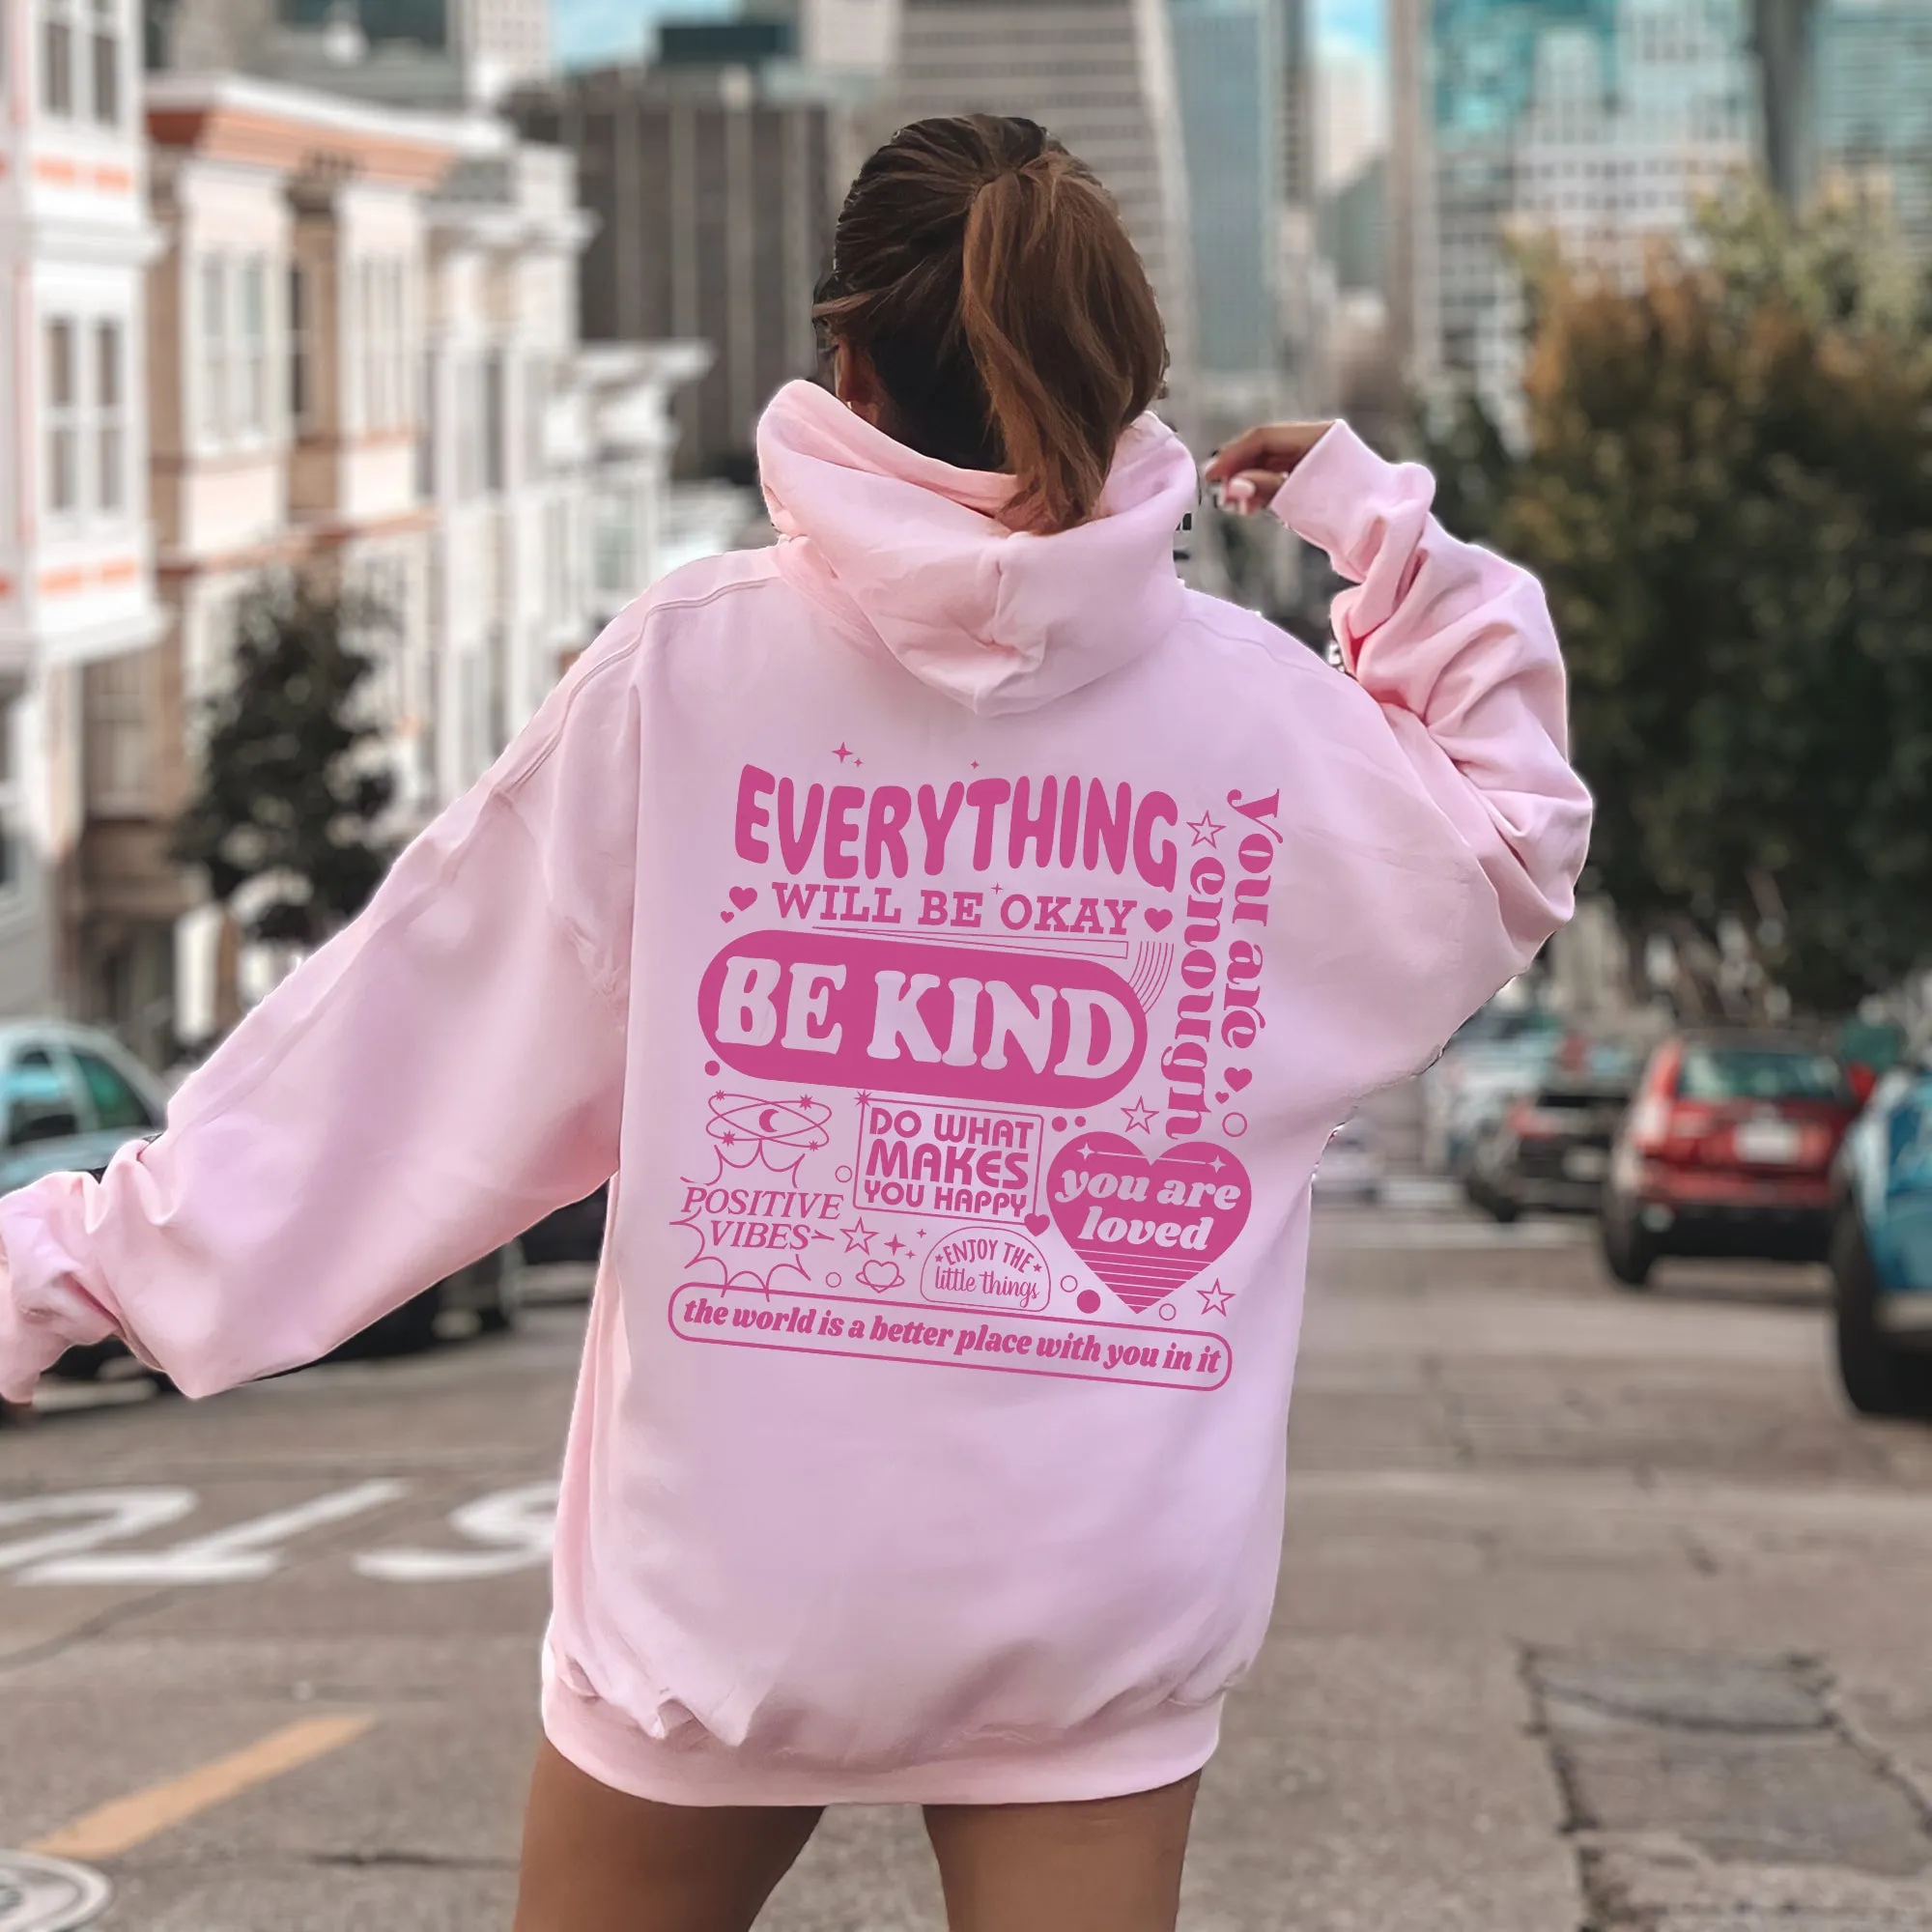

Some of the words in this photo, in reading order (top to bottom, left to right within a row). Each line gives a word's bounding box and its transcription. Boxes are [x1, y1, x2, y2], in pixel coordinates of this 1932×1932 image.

[735, 764, 1179, 894] EVERYTHING
[1227, 788, 1284, 926] you
[772, 881, 901, 924] WILL
[918, 889, 984, 928] BE
[999, 895, 1138, 936] OKAY
[716, 955, 847, 1055] BE
[867, 970, 1135, 1079] KIND
[1161, 856, 1226, 1140] enough
[1220, 939, 1266, 1050] are
[869, 1106, 923, 1139] DO
[933, 1112, 1035, 1150] WHAT
[866, 1138, 1029, 1191] MAKES
[680, 1185, 844, 1220] POSITIVE
[864, 1179, 925, 1208] YOU
[933, 1185, 1028, 1218] HAPPY
[1054, 1169, 1150, 1203] you
[1157, 1179, 1241, 1210] are
[710, 1220, 811, 1251] VIBES
[1077, 1205, 1214, 1251] loved
[942, 1238, 999, 1266] ENJOY
[1003, 1241, 1035, 1273] THE
[934, 1265, 977, 1293] little
[979, 1270, 1040, 1309] things
[683, 1297, 729, 1326] the
[732, 1306, 817, 1335] world
[817, 1309, 844, 1338] is
[847, 1319, 866, 1340] a
[868, 1315, 954, 1348] better
[953, 1323, 1033, 1356] place
[1036, 1332, 1101, 1362] with
[1102, 1344, 1160, 1371] you
[1161, 1342, 1193, 1372] in
[1195, 1345, 1221, 1374] it
